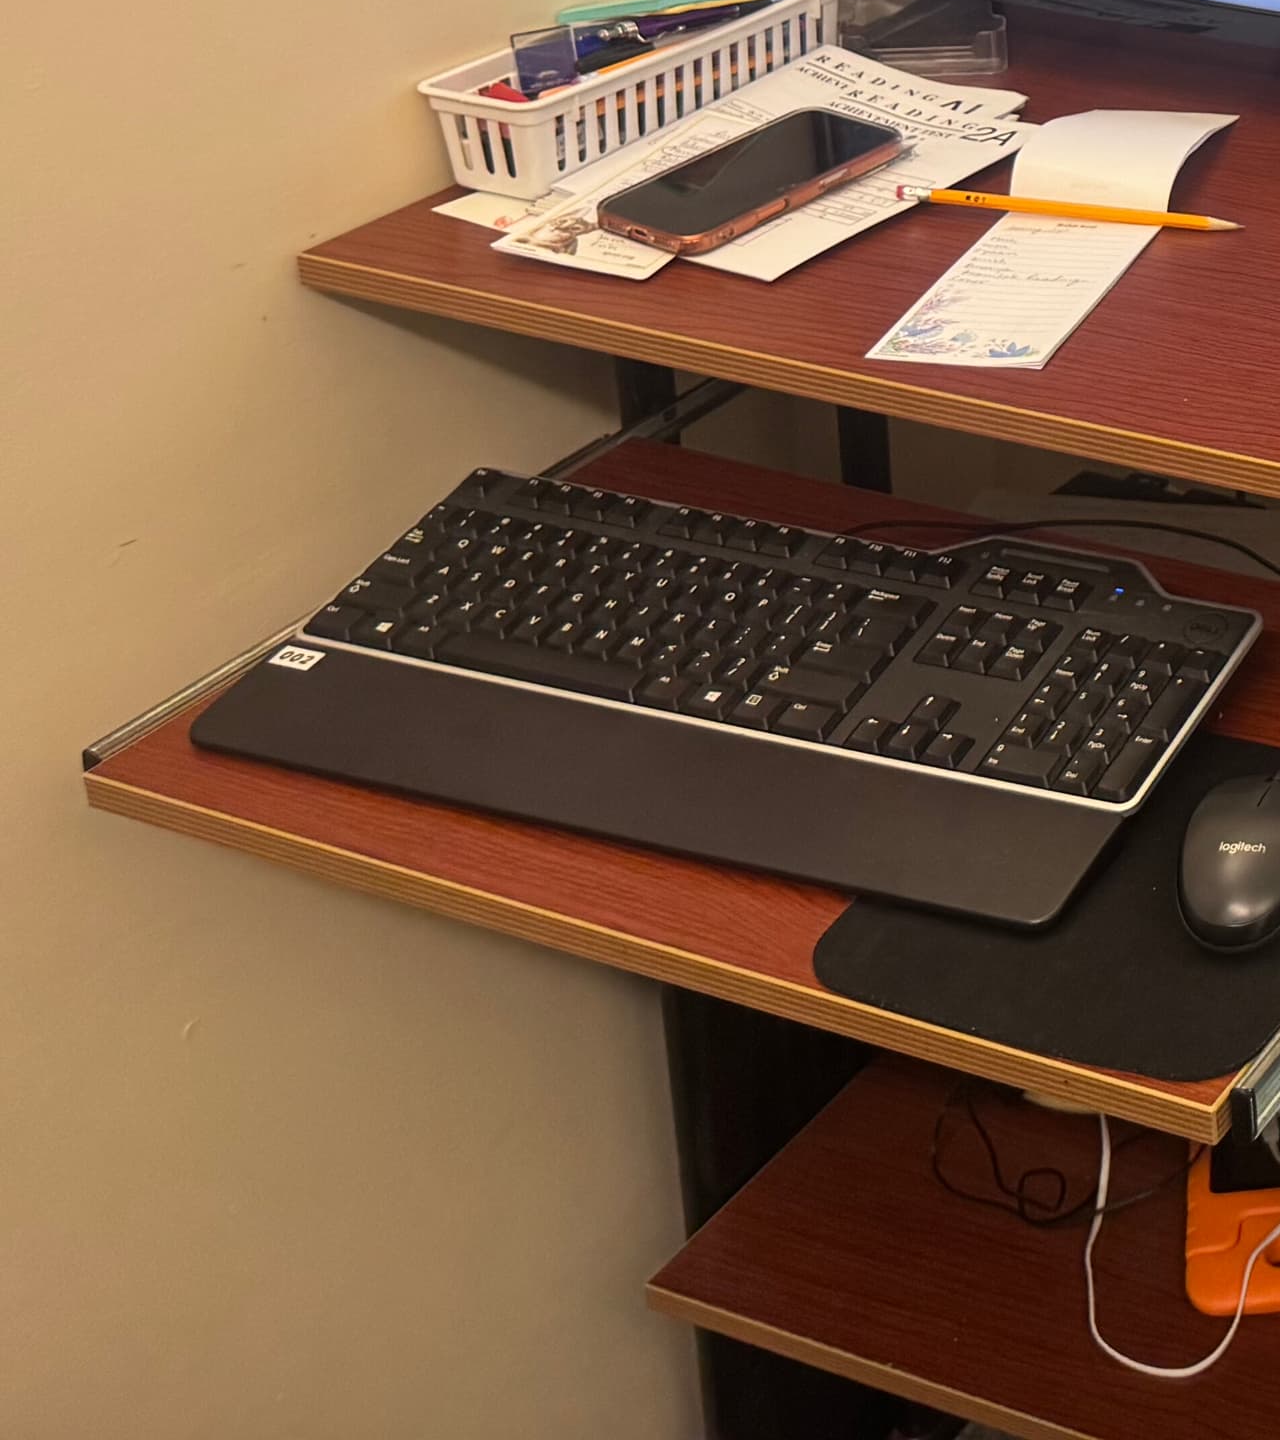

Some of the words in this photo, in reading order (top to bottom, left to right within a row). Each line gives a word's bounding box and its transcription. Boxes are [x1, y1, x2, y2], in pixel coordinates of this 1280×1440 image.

[796, 66, 848, 90] ACHIEVE
[815, 55, 938, 102] READING
[825, 101, 919, 132] ACHIEVEMENT
[920, 128, 956, 139] TEST
[846, 89, 980, 130] READING
[959, 127, 1017, 146] 2A
[458, 539, 469, 548] Q
[438, 565, 450, 575] A
[470, 572, 482, 582] S
[624, 571, 635, 581] Y
[656, 578, 668, 588] U
[571, 593, 583, 602] G
[724, 592, 736, 602] O
[460, 601, 473, 611] X
[605, 599, 617, 608] H
[495, 609, 506, 618] C
[673, 613, 685, 623] K
[530, 616, 541, 625] V
[595, 629, 609, 639] N
[631, 636, 645, 646] M
[279, 651, 315, 665] 002
[1218, 841, 1266, 854] logitech
